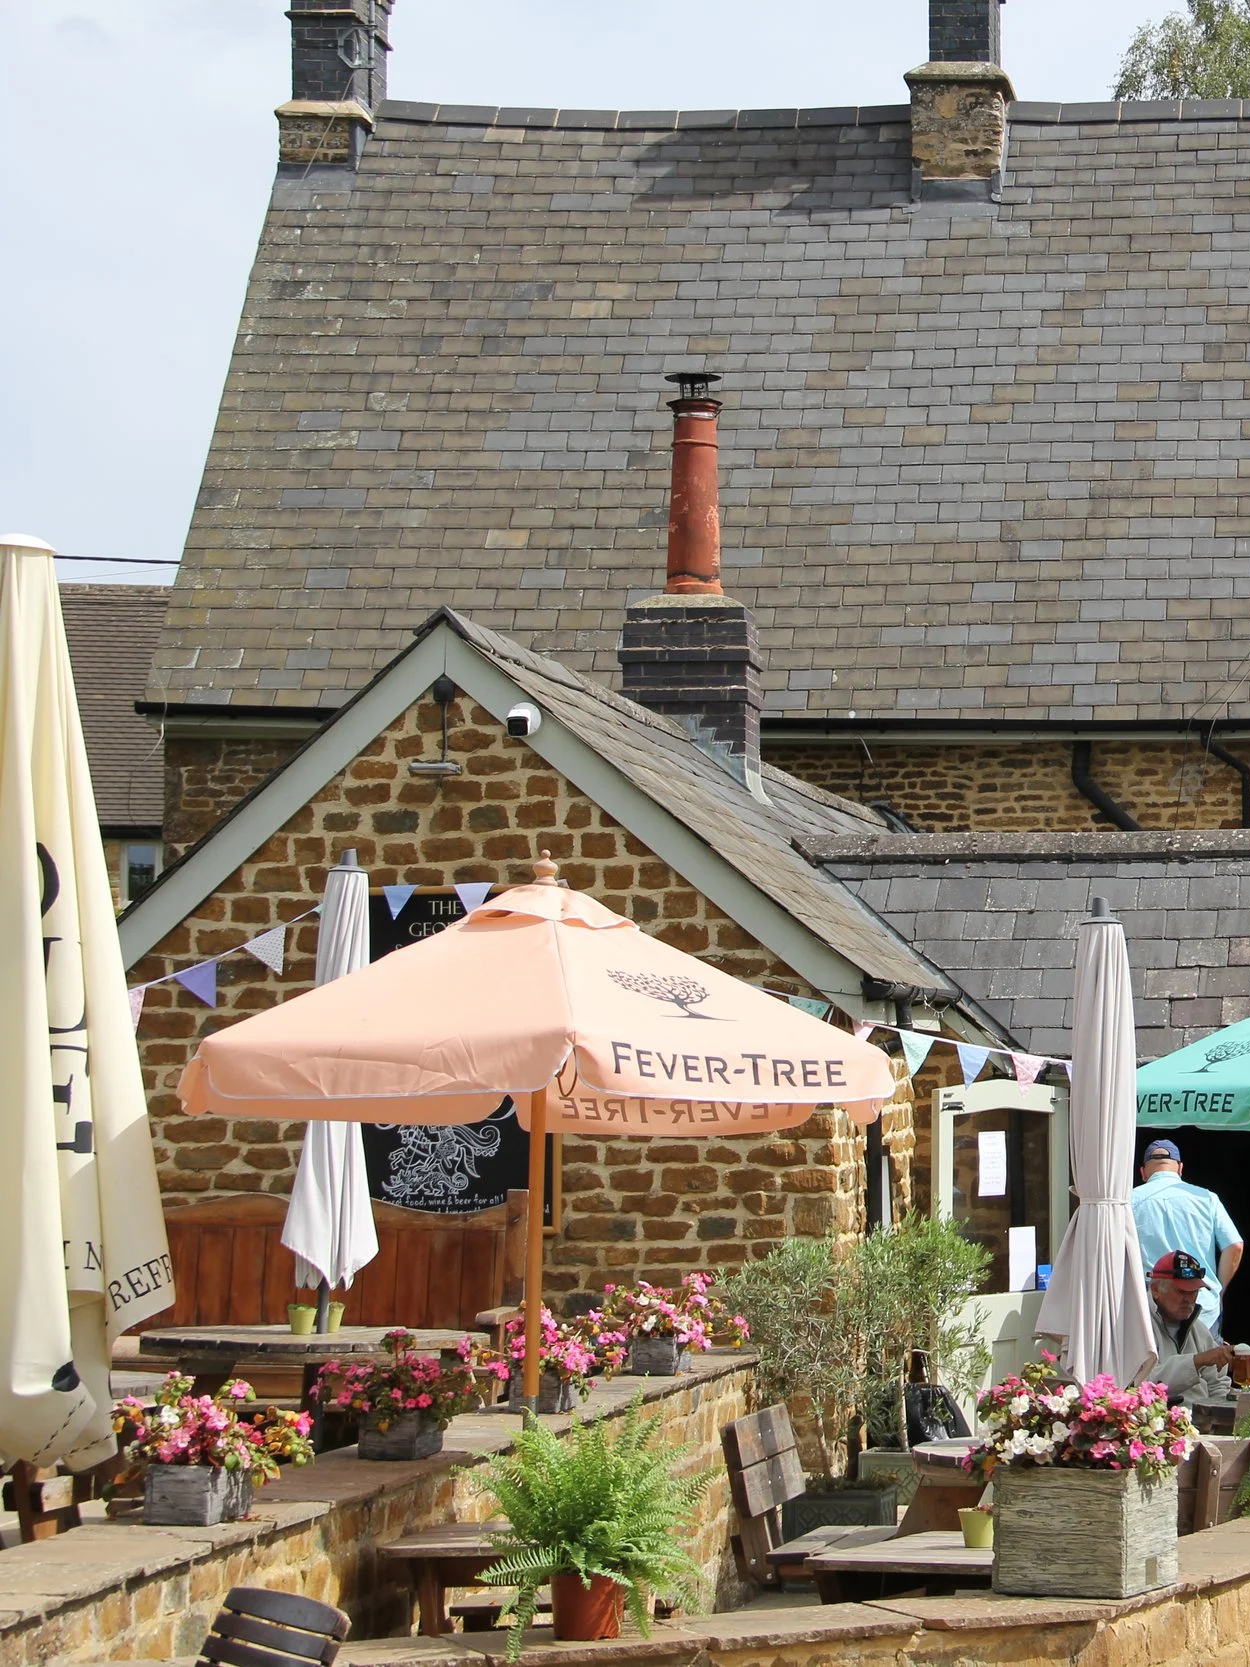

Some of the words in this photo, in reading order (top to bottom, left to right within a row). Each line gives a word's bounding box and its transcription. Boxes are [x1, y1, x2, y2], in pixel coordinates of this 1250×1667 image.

[428, 900, 462, 915] THE
[409, 921, 452, 937] GEO
[611, 1041, 847, 1087] FEVER-TREE
[1136, 1089, 1235, 1114] VER-TREE
